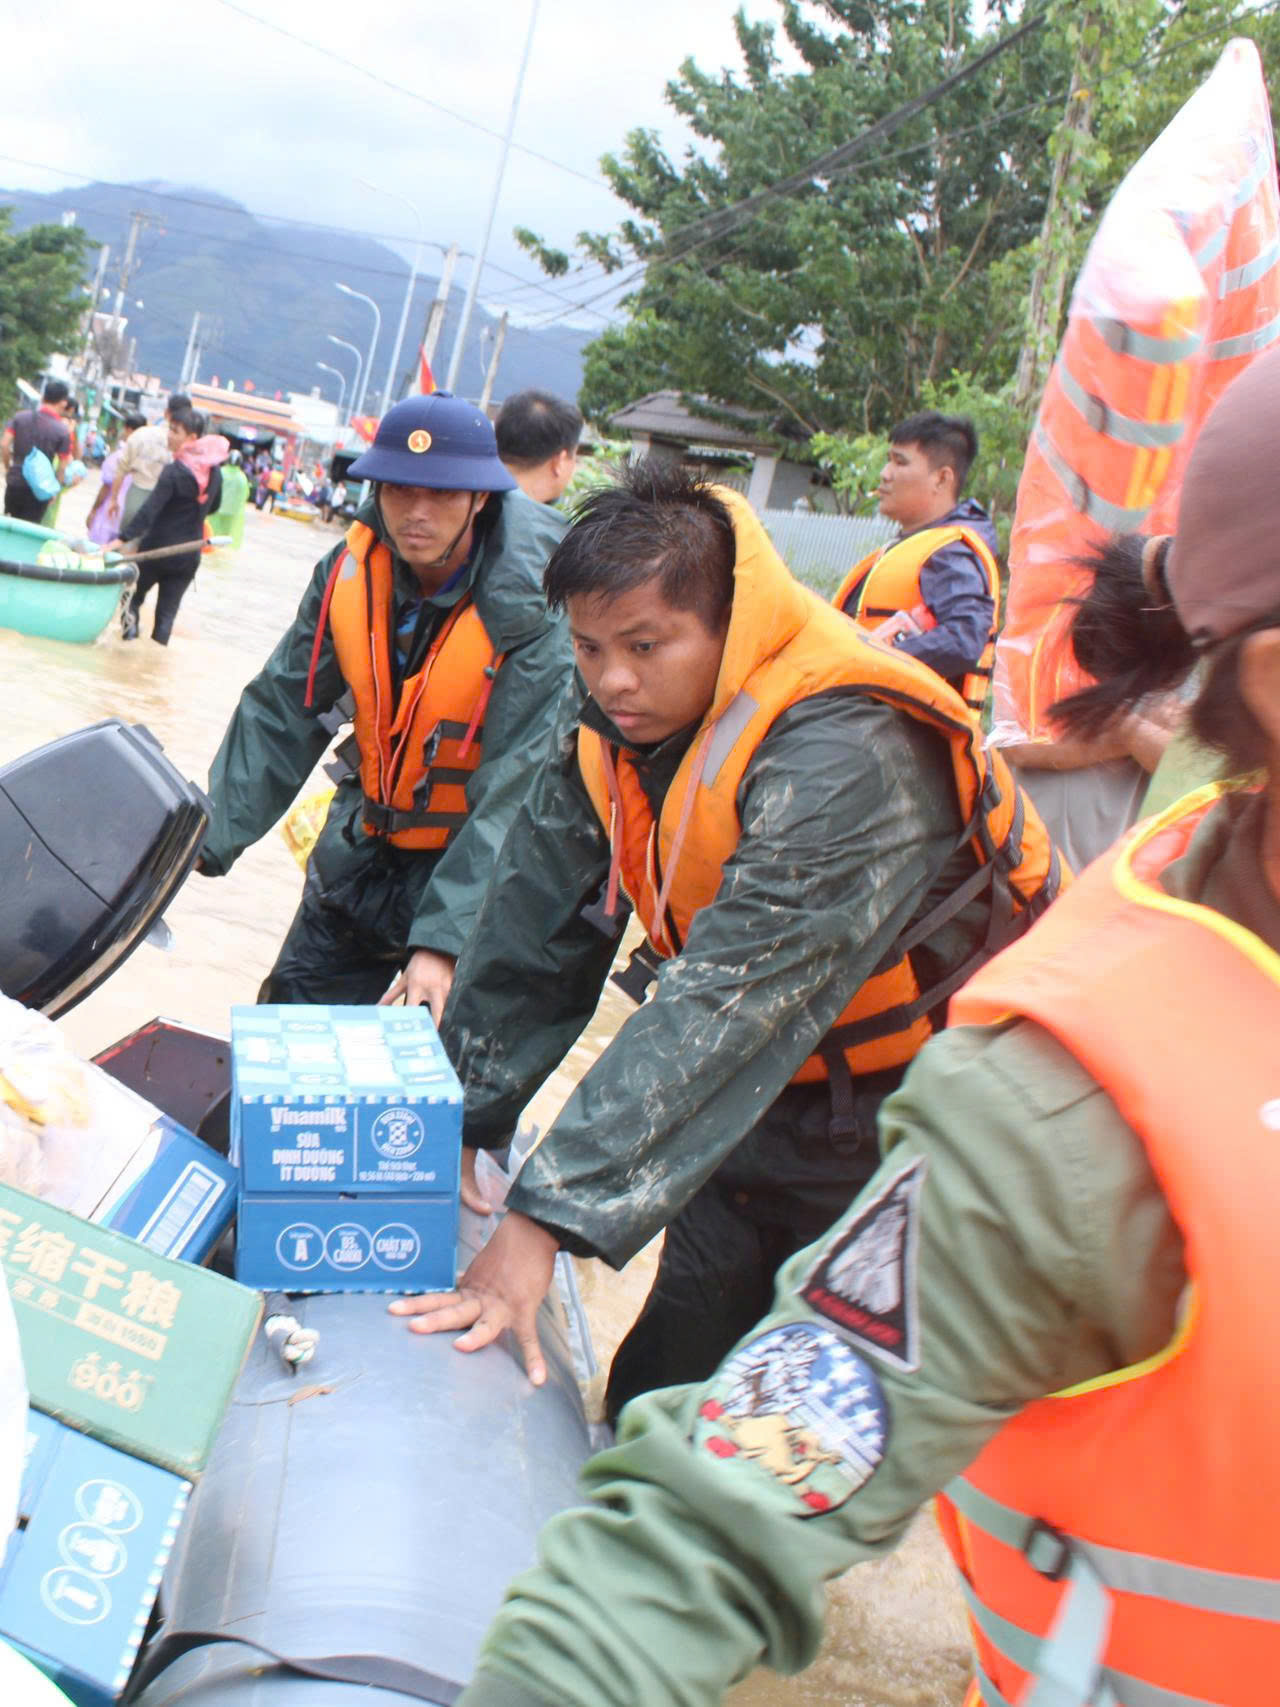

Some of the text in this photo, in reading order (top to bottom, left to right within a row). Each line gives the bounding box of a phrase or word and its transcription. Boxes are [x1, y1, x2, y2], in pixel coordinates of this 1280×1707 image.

[271, 1107, 346, 1126] Vinamilk
[296, 1131, 320, 1148] SỮA
[272, 1150, 301, 1165] DINH
[295, 1239, 308, 1261] A
[72, 1361, 142, 1409] 900
